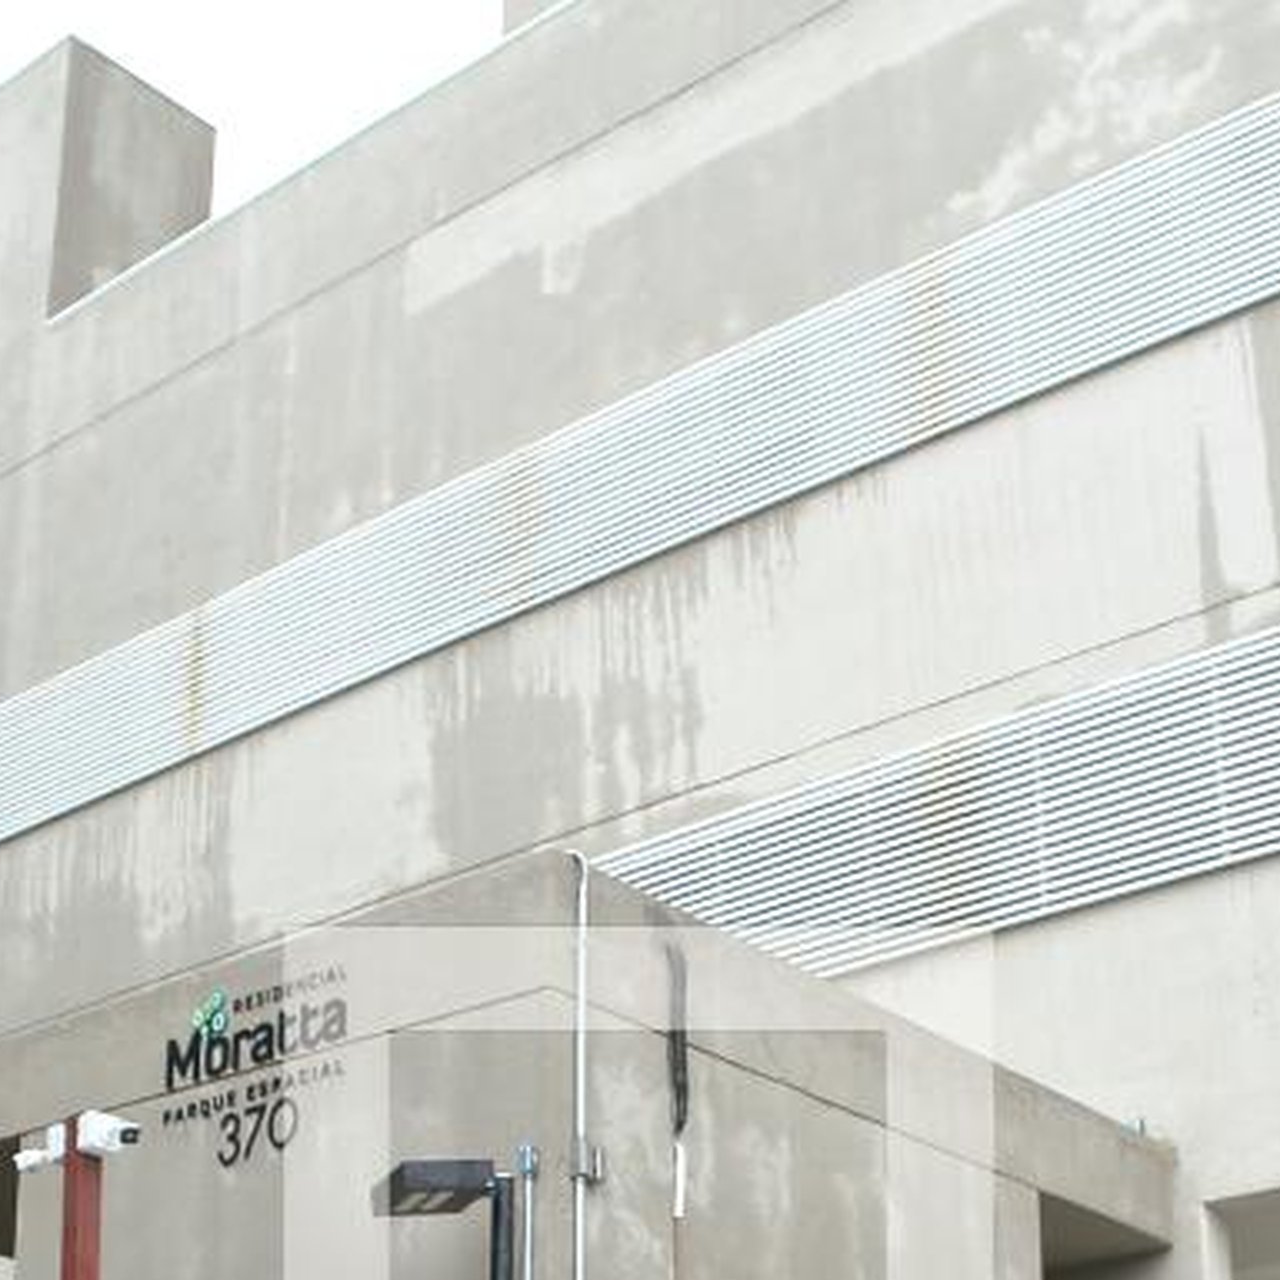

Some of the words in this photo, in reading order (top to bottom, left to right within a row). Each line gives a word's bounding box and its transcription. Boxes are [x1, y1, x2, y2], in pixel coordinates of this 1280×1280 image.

[232, 964, 347, 1012] RESIDENCIAL
[166, 998, 348, 1093] Moratta
[163, 1090, 237, 1126] PARQUE
[245, 1060, 346, 1102] ESPACIAL
[217, 1097, 298, 1168] 370
